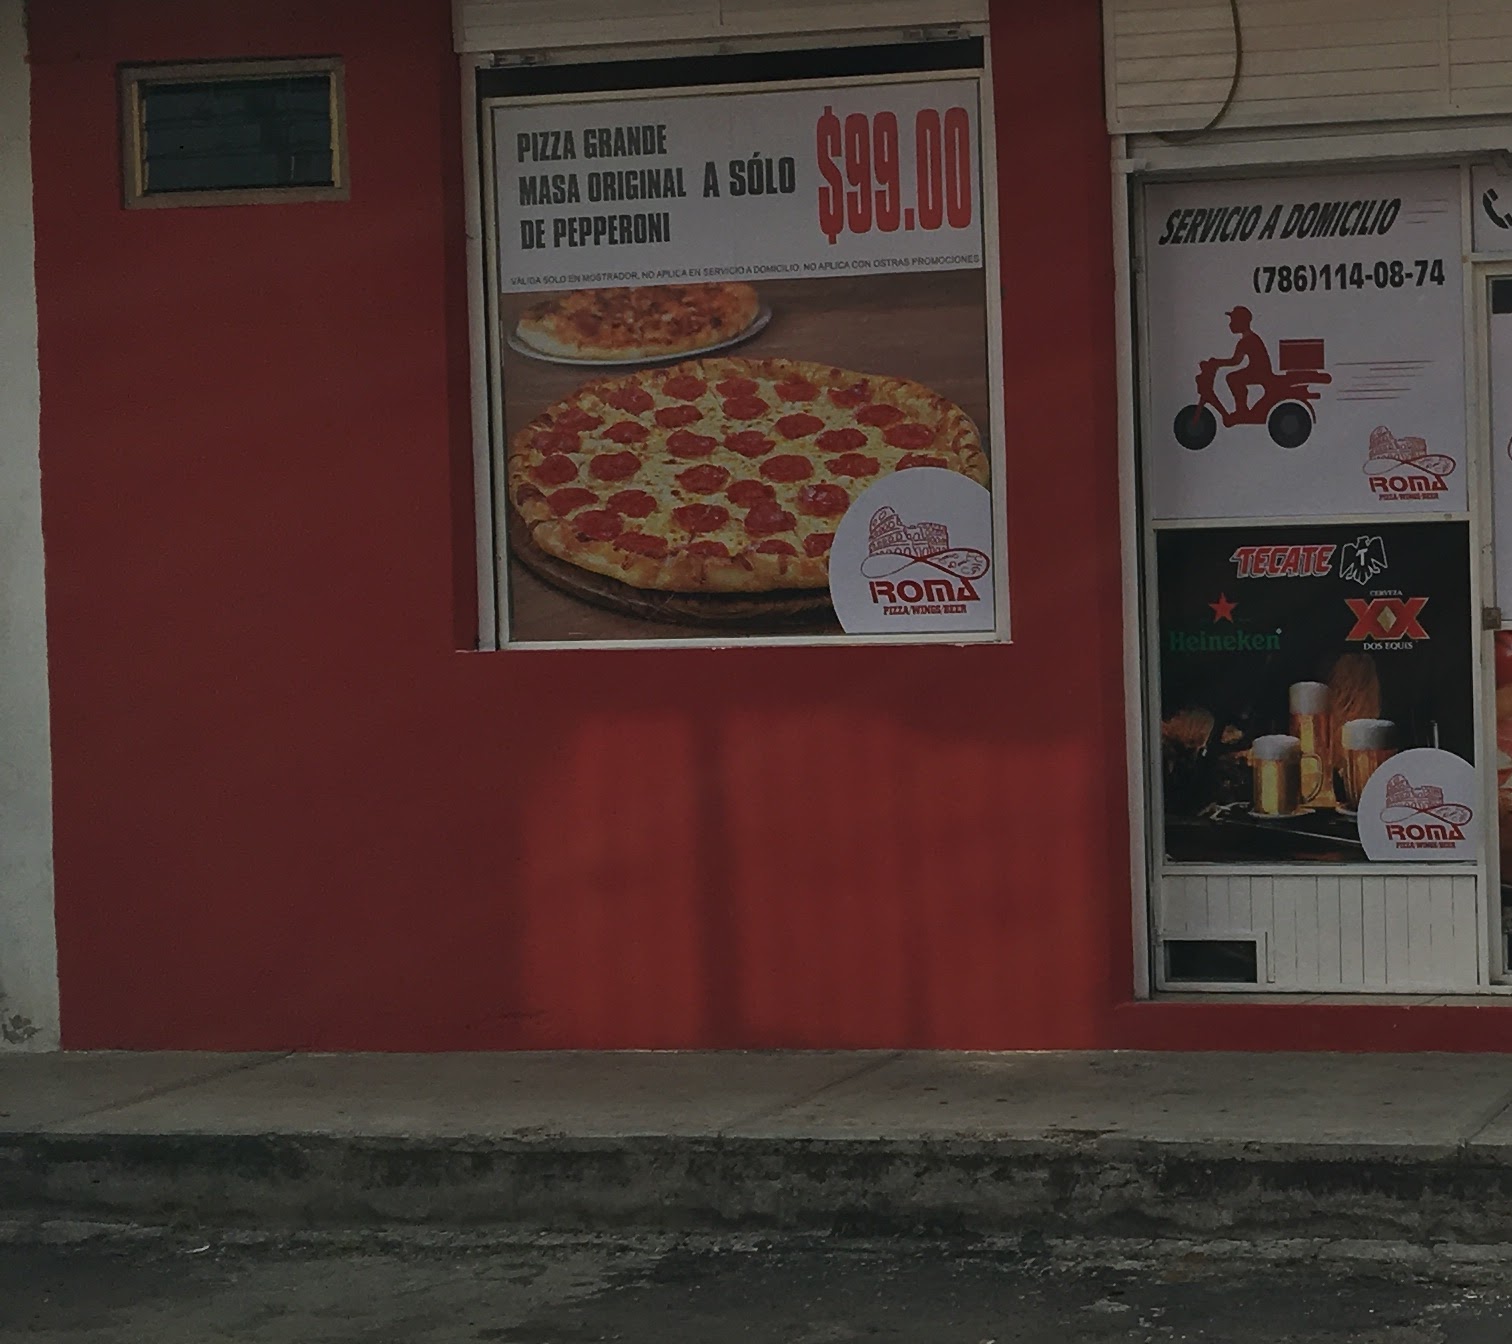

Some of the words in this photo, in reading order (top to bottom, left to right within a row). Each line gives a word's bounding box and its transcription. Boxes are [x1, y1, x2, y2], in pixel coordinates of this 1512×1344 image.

[517, 130, 577, 163] PIZZA
[583, 124, 667, 158] GRANDE
[519, 174, 581, 206] MASA
[587, 168, 687, 203] ORIGINAL
[703, 162, 720, 198] A
[729, 152, 796, 196] SÓLO
[816, 105, 973, 245] $99.00
[520, 218, 546, 250] DE
[553, 212, 671, 247] PEPPERONI
[1158, 205, 1263, 246] SERVICIO
[1258, 204, 1283, 240] A
[1280, 198, 1402, 240] DOMICILIO
[1253, 259, 1445, 294] (786)114-08-74
[1369, 474, 1448, 492] ROMA
[1230, 544, 1336, 579] TECATE
[869, 578, 980, 603] ROMA
[1169, 629, 1280, 653] Heineken
[1363, 642, 1383, 650] DOS
[1386, 824, 1466, 840] ROMA
